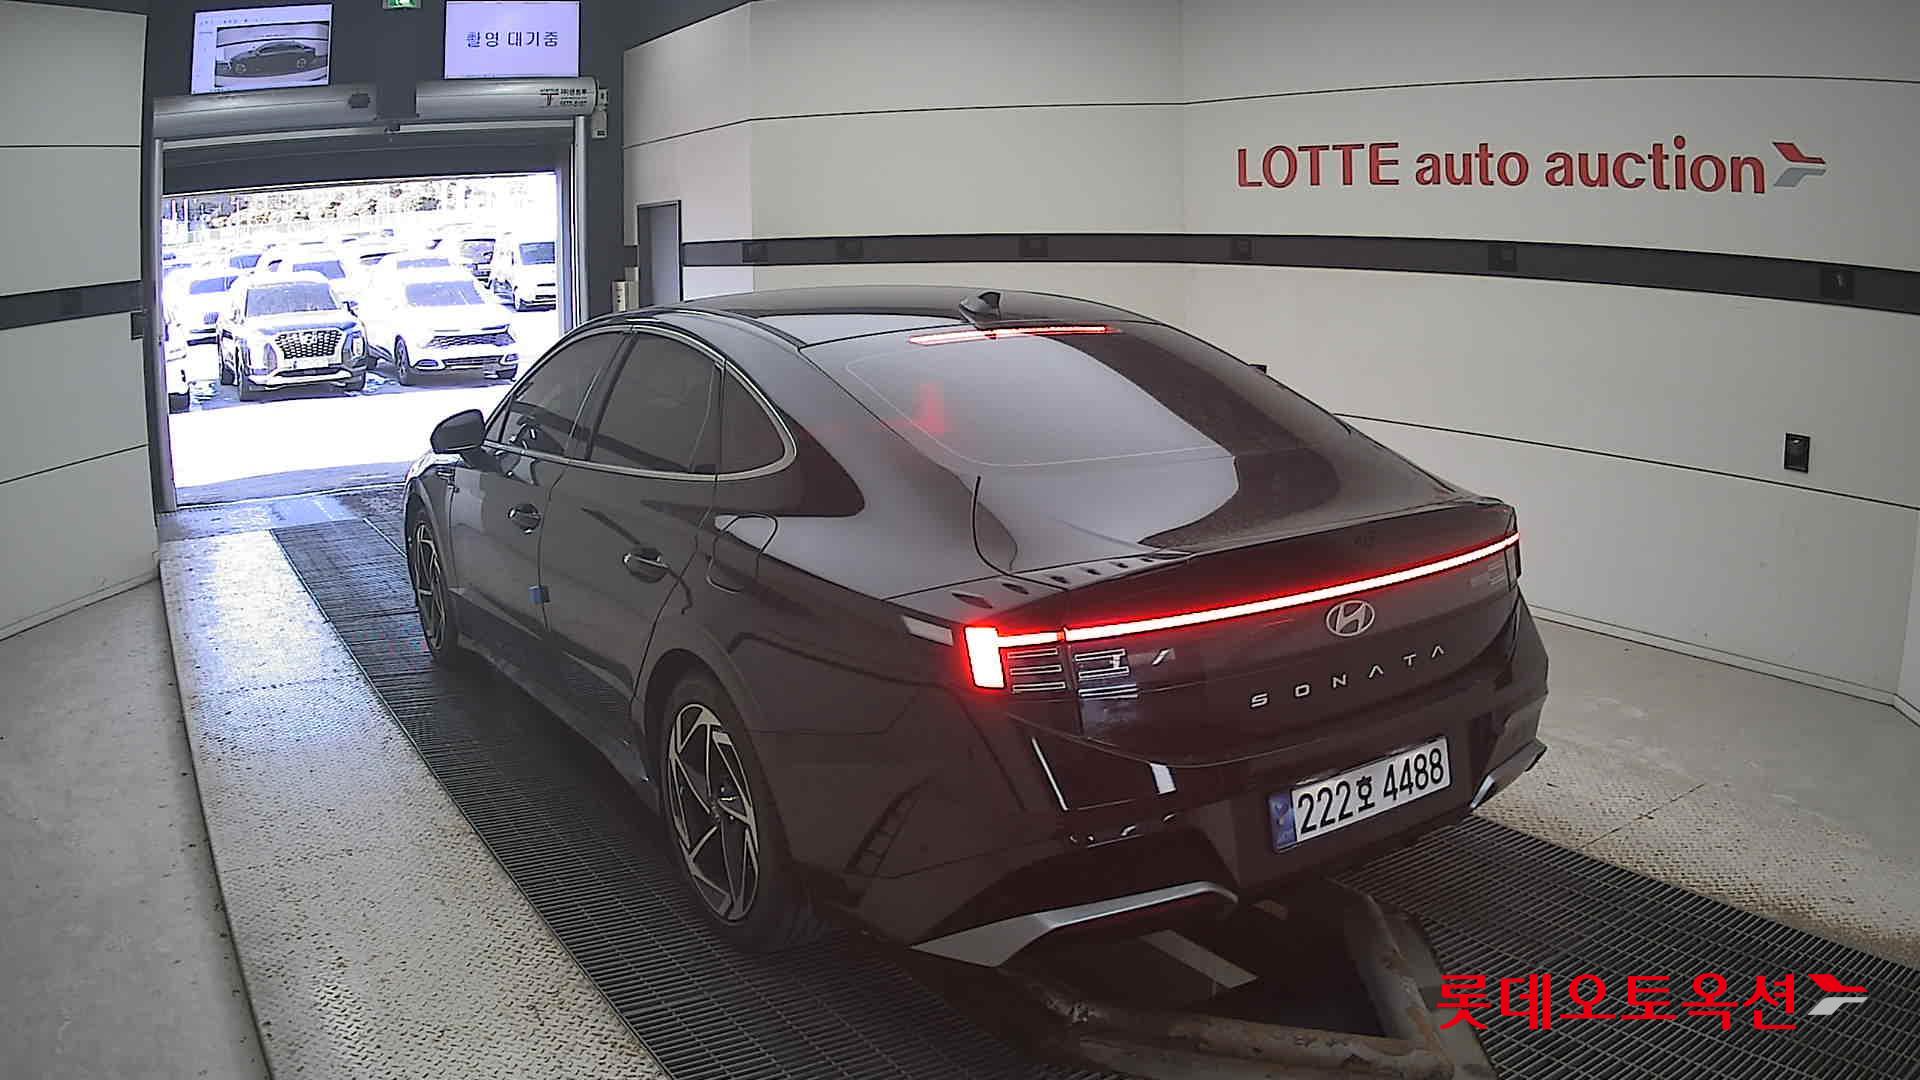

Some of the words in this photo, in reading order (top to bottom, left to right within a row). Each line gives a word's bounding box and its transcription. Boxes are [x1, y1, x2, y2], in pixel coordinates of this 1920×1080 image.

[507, 31, 559, 48] 대기중
[1236, 141, 1400, 189] LOTTE
[1415, 142, 1530, 187] auto
[1544, 135, 1767, 194] auction
[1249, 645, 1446, 709] SONATA
[1297, 776, 1376, 835] 222호
[1383, 747, 1444, 802] 4488
